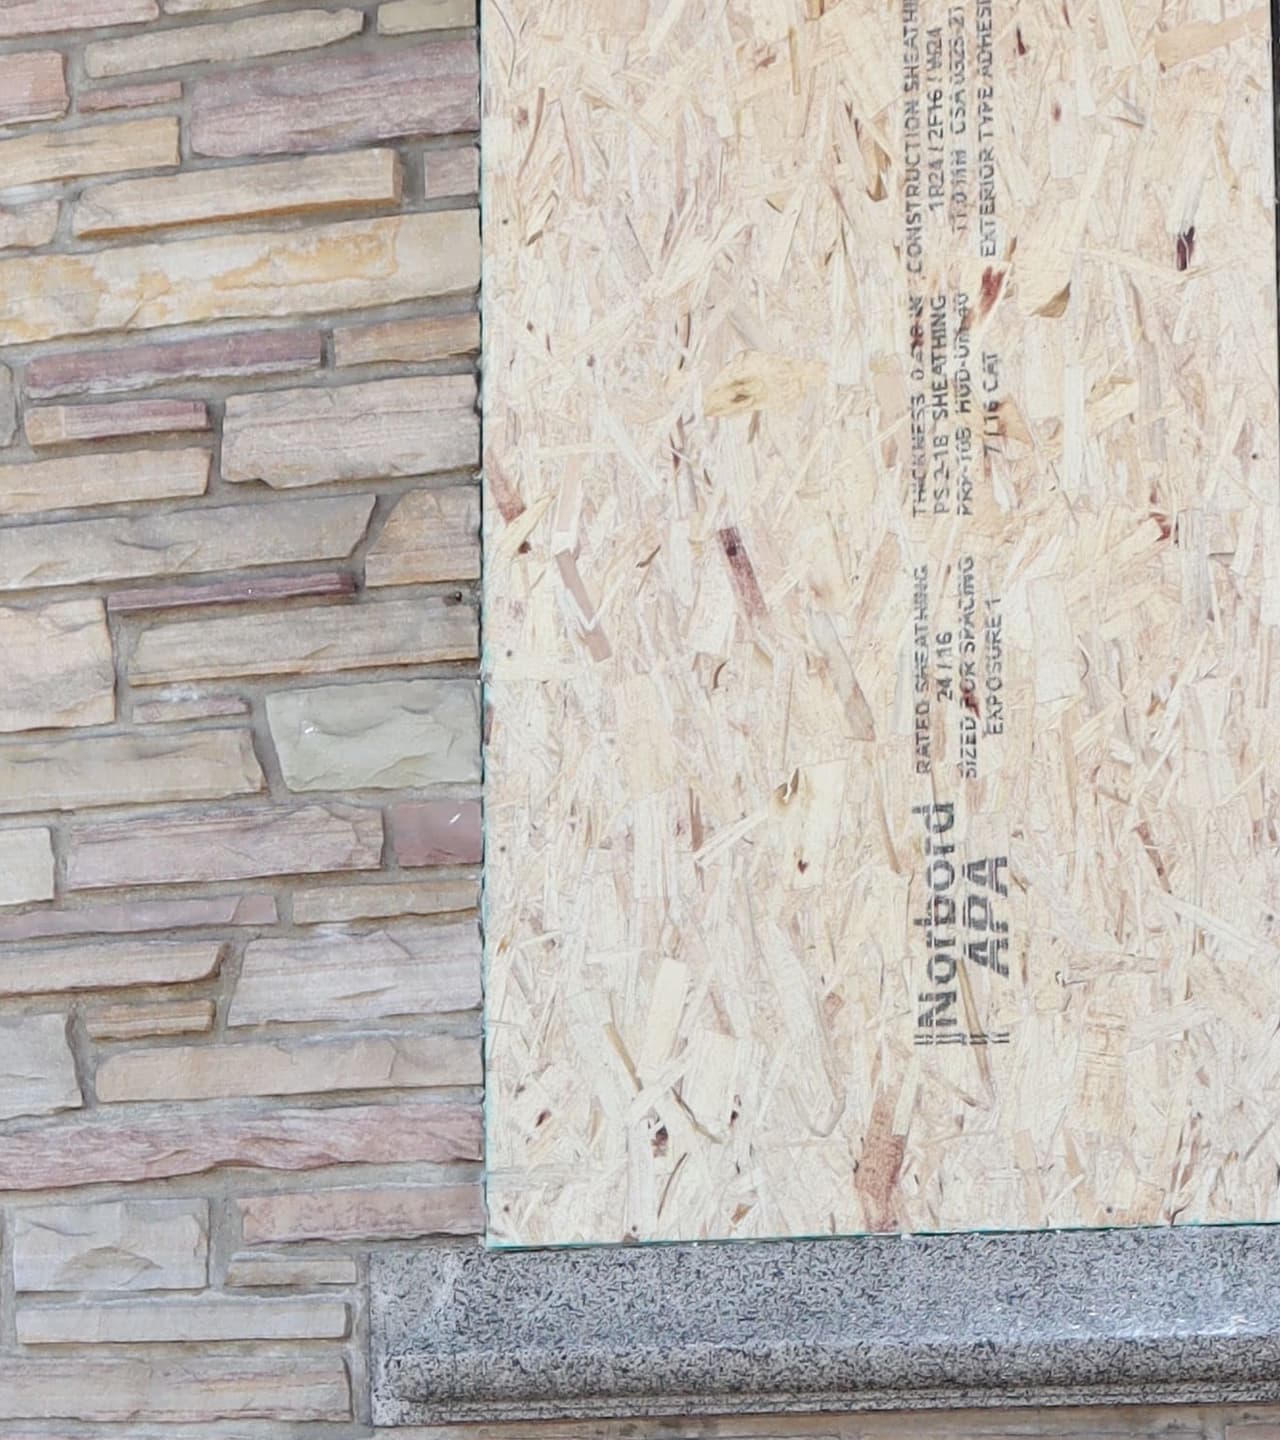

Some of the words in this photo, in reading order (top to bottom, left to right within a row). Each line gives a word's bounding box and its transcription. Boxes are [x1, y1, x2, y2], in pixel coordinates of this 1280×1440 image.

[977, 86, 994, 142] TYPE
[904, 99, 922, 273] CONSTRUCTION
[978, 146, 996, 257] EXTERIOR
[930, 295, 949, 420] SHEATHING
[982, 351, 998, 393] CAT
[911, 393, 926, 518] THICKNESS
[913, 564, 929, 693] SHEATHING
[958, 555, 975, 654] SPACING
[985, 615, 1004, 735] EXPOSURE
[915, 701, 931, 774] RATED
[960, 717, 977, 779] SIZED
[912, 802, 957, 1028] Norbord
[962, 856, 1009, 980] APA
